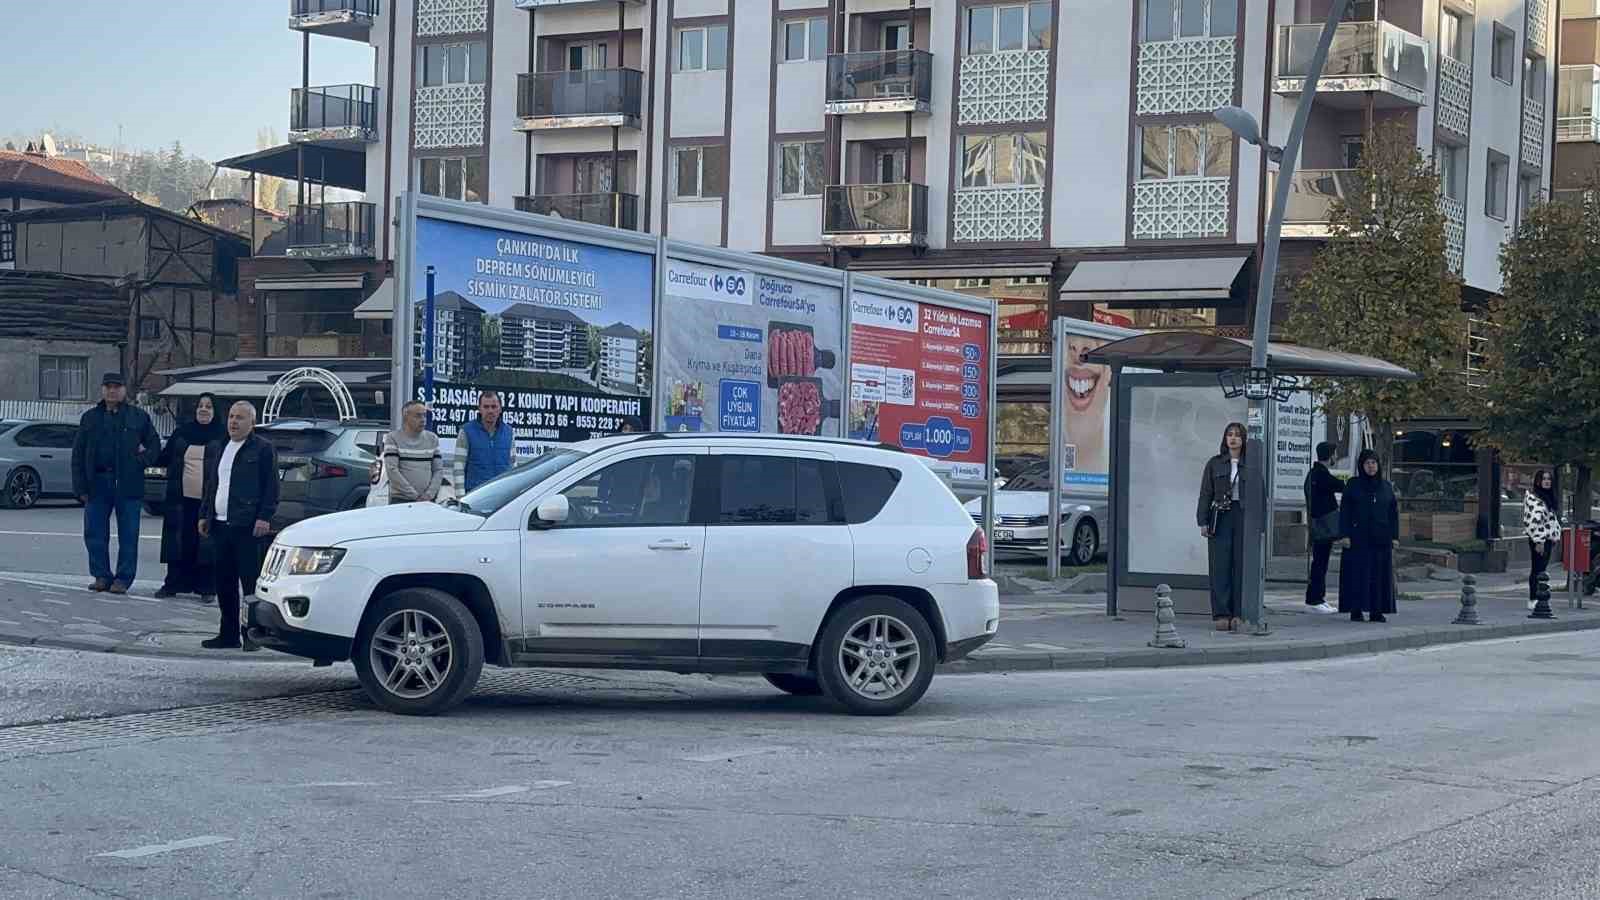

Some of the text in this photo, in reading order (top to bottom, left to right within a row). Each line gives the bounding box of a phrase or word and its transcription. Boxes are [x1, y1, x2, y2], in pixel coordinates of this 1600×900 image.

[563, 243, 579, 263] İLK
[476, 258, 522, 278] DEPREM
[668, 270, 707, 288] Carrefour
[760, 278, 793, 295] Doğruca
[732, 386, 748, 401] ÇOK
[508, 392, 515, 408] 2
[518, 392, 551, 410] KONUT
[554, 395, 578, 412] YAPI
[580, 397, 641, 417] KOOPERATİFİ
[727, 400, 752, 413] UYGUN
[437, 423, 457, 435] CEMİL
[449, 409, 466, 423] 497
[502, 411, 524, 426] 0542
[544, 414, 555, 427] 73
[598, 418, 613, 431] 228
